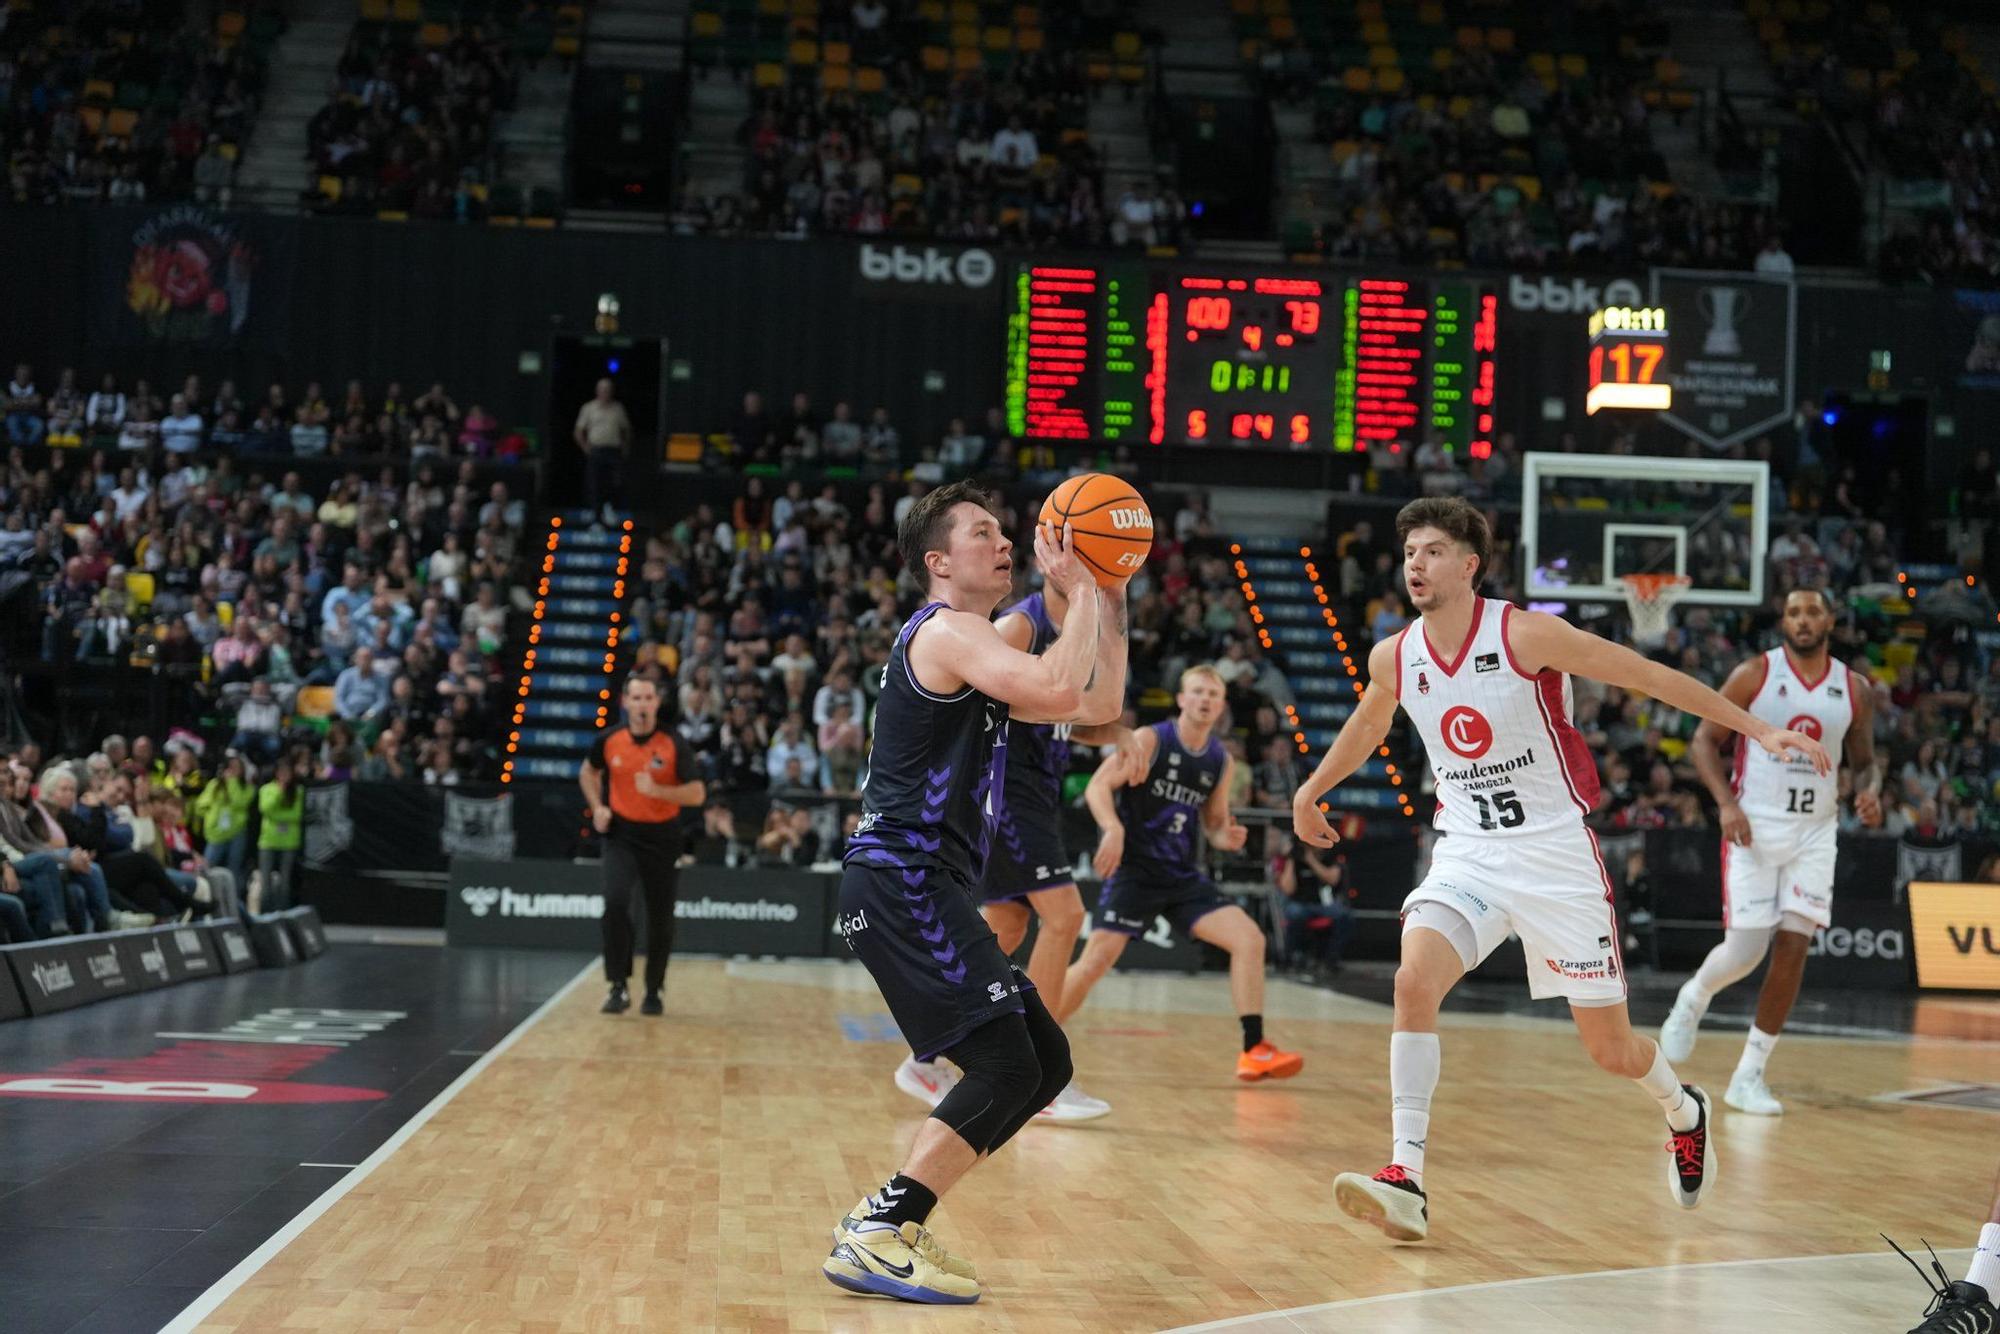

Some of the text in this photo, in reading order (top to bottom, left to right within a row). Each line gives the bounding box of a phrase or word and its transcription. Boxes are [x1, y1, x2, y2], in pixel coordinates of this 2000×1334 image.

[860, 244, 955, 283] bbk
[1187, 297, 1231, 330] 100
[1285, 300, 1320, 334] 73
[1604, 306, 1665, 331] 01:11
[1243, 325, 1262, 351] 4
[1608, 343, 1664, 385] 17
[1471, 790, 1526, 831] 15
[1786, 787, 1815, 814] 12
[1168, 812, 1188, 835] 3
[500, 887, 605, 918] humme
[673, 897, 798, 922] zulmarino
[1559, 959, 1604, 972] Zaragoza
